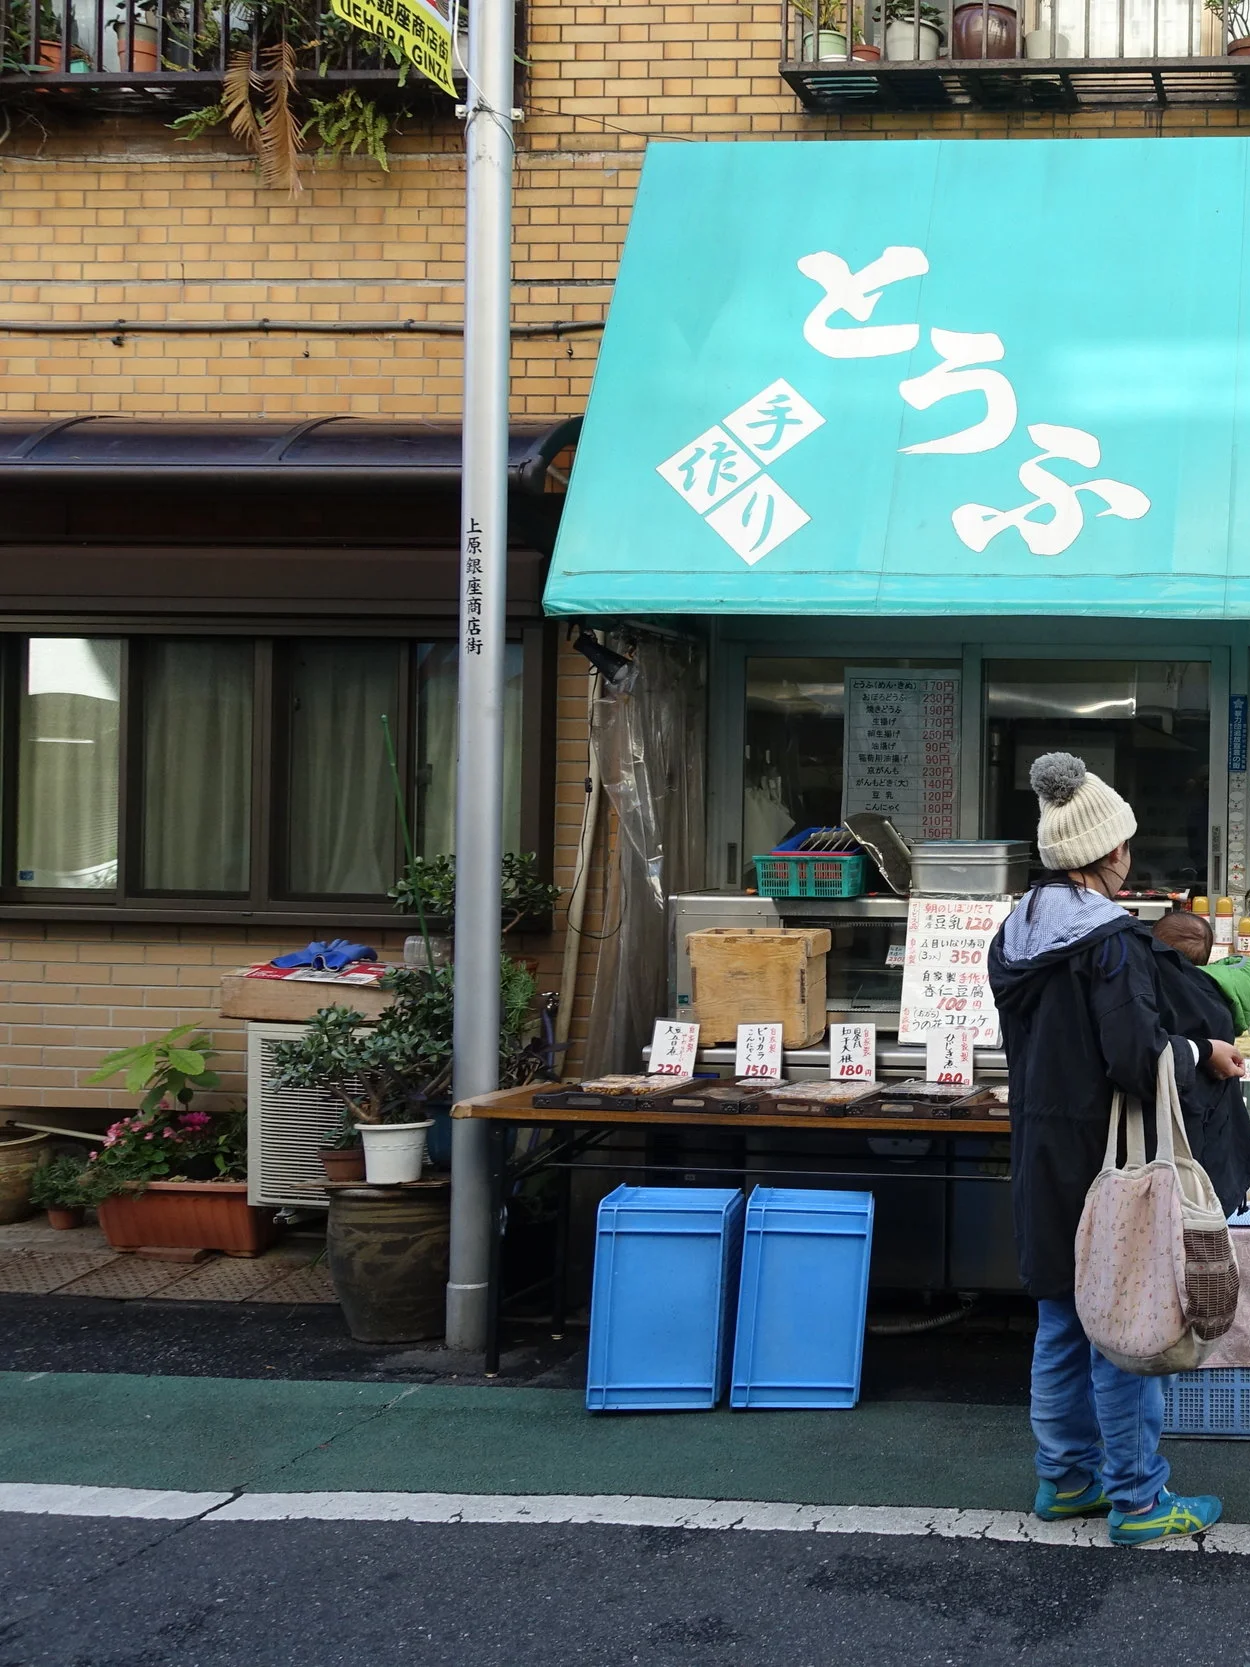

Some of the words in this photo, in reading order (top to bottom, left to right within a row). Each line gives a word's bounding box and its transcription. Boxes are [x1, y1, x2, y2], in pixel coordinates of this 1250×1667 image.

[412, 44, 451, 89] GINZA
[796, 245, 1151, 557] とうふ
[672, 390, 808, 556] 手作り
[466, 518, 483, 655] 上原銀座商店街
[924, 682, 954, 692] 170円
[923, 694, 954, 704] 230円
[923, 706, 954, 716] 190円
[923, 718, 954, 728] 170円
[923, 730, 953, 741] 250円
[925, 743, 950, 753] 90円
[926, 755, 950, 765] 90円
[922, 767, 953, 777] 230円
[923, 779, 953, 789] 140円
[923, 791, 953, 801] 120円
[865, 803, 900, 811] こんにゃく
[923, 803, 952, 814] 180円
[922, 815, 952, 826] 210円
[923, 828, 952, 838] 150円
[924, 904, 994, 914] 朝のしぼりたて
[934, 915, 964, 930] 豆乳
[950, 950, 982, 964] 350
[922, 970, 957, 982] 自家製
[922, 984, 985, 998] 杏仁豆腐
[745, 1029, 755, 1062] こんにゃく
[756, 1027, 768, 1060] ピリカラ
